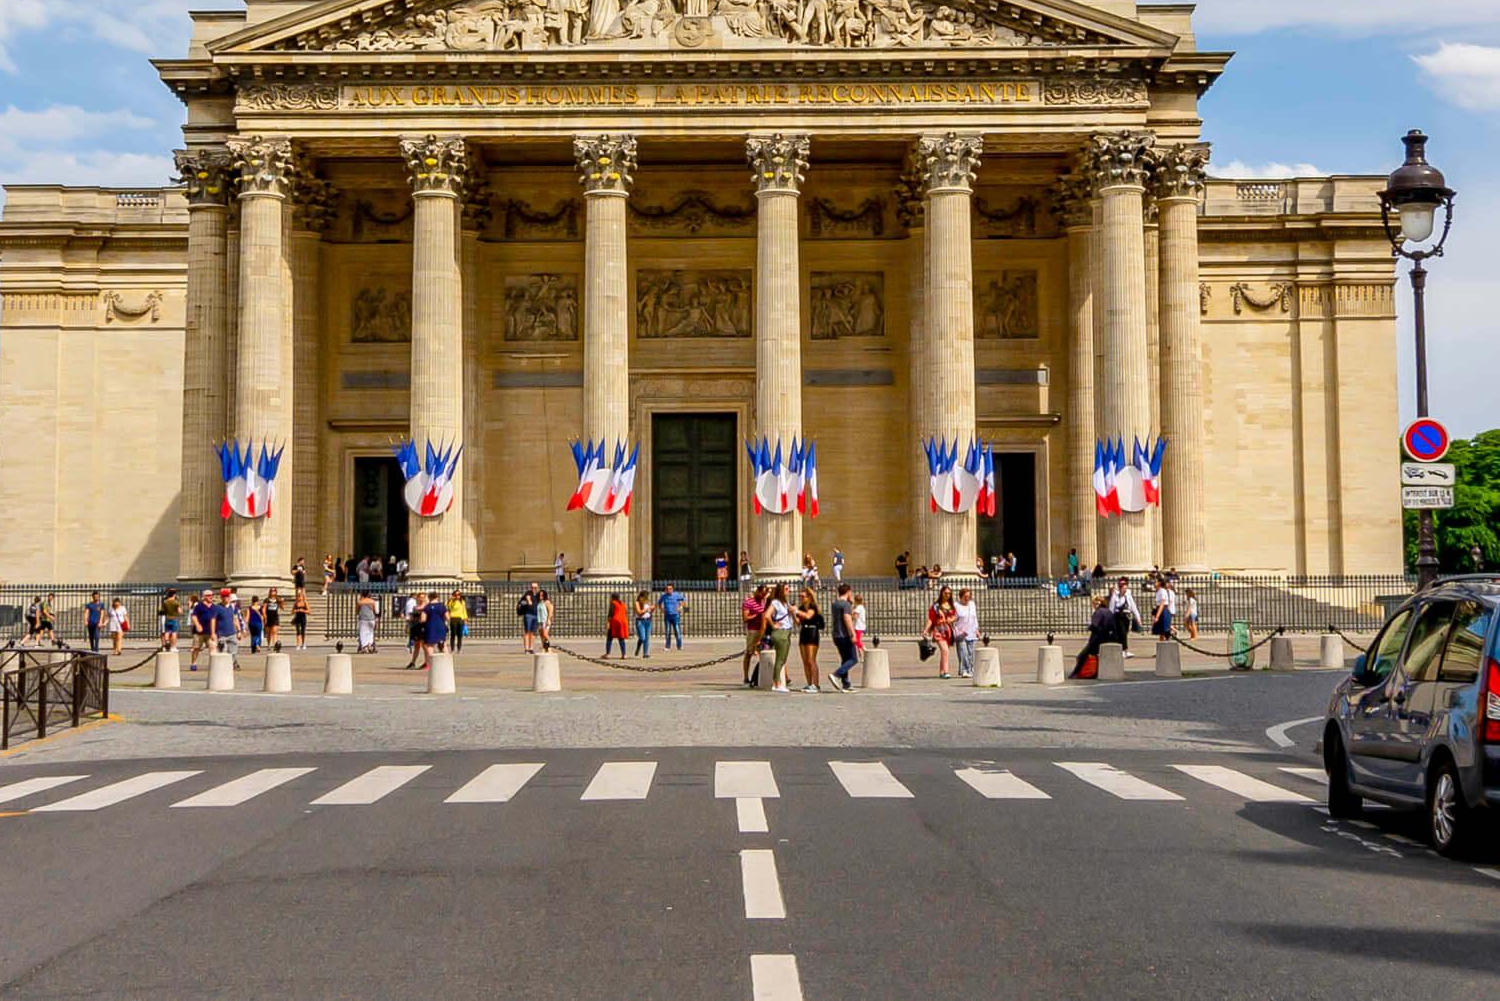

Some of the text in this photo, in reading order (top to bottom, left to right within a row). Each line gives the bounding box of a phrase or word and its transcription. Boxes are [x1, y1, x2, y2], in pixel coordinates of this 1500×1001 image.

[348, 82, 1032, 106] AUX GRANDS HOMMES LA PATRIE RECONNAISSANTE
